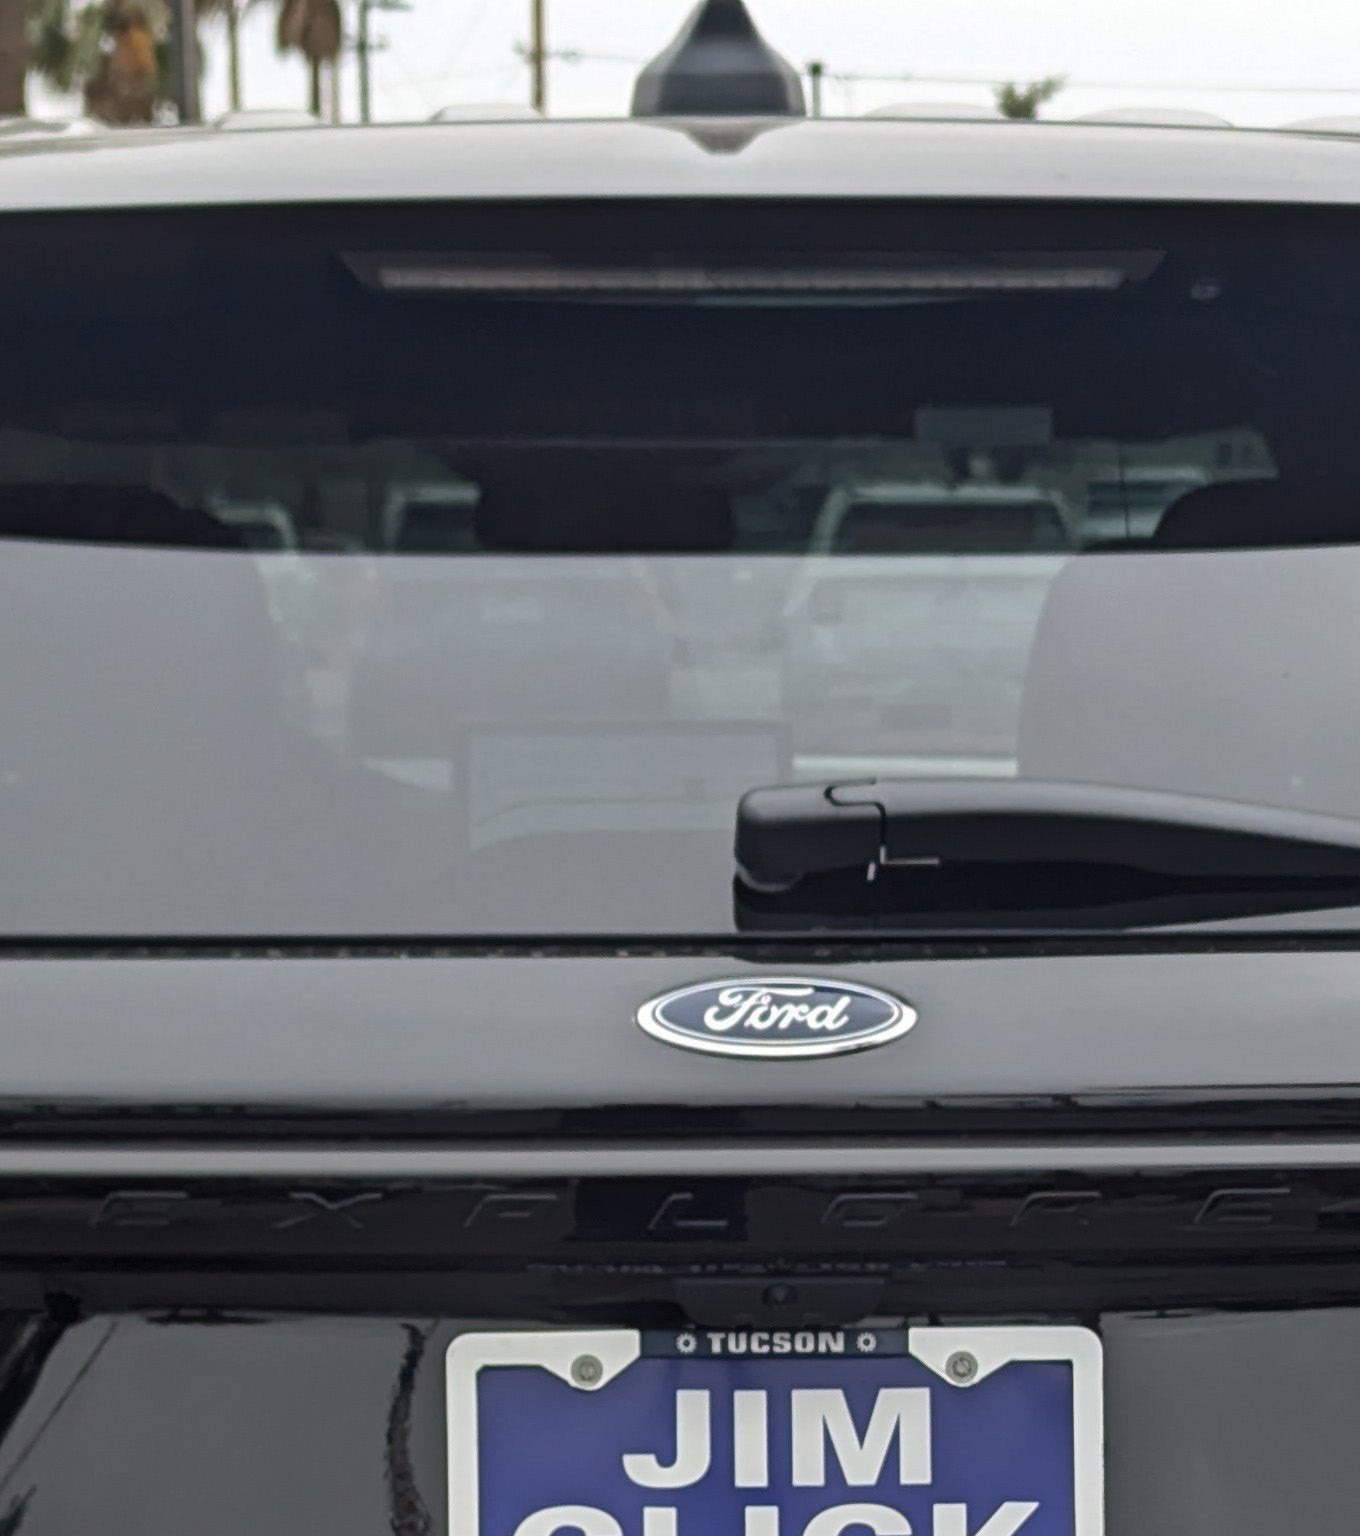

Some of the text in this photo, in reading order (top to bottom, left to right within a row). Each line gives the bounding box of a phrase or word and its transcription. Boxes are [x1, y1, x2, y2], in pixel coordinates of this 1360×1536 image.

[704, 986, 851, 1032] Ford
[707, 1331, 845, 1354] TUCSON
[622, 1387, 932, 1489] JIM
